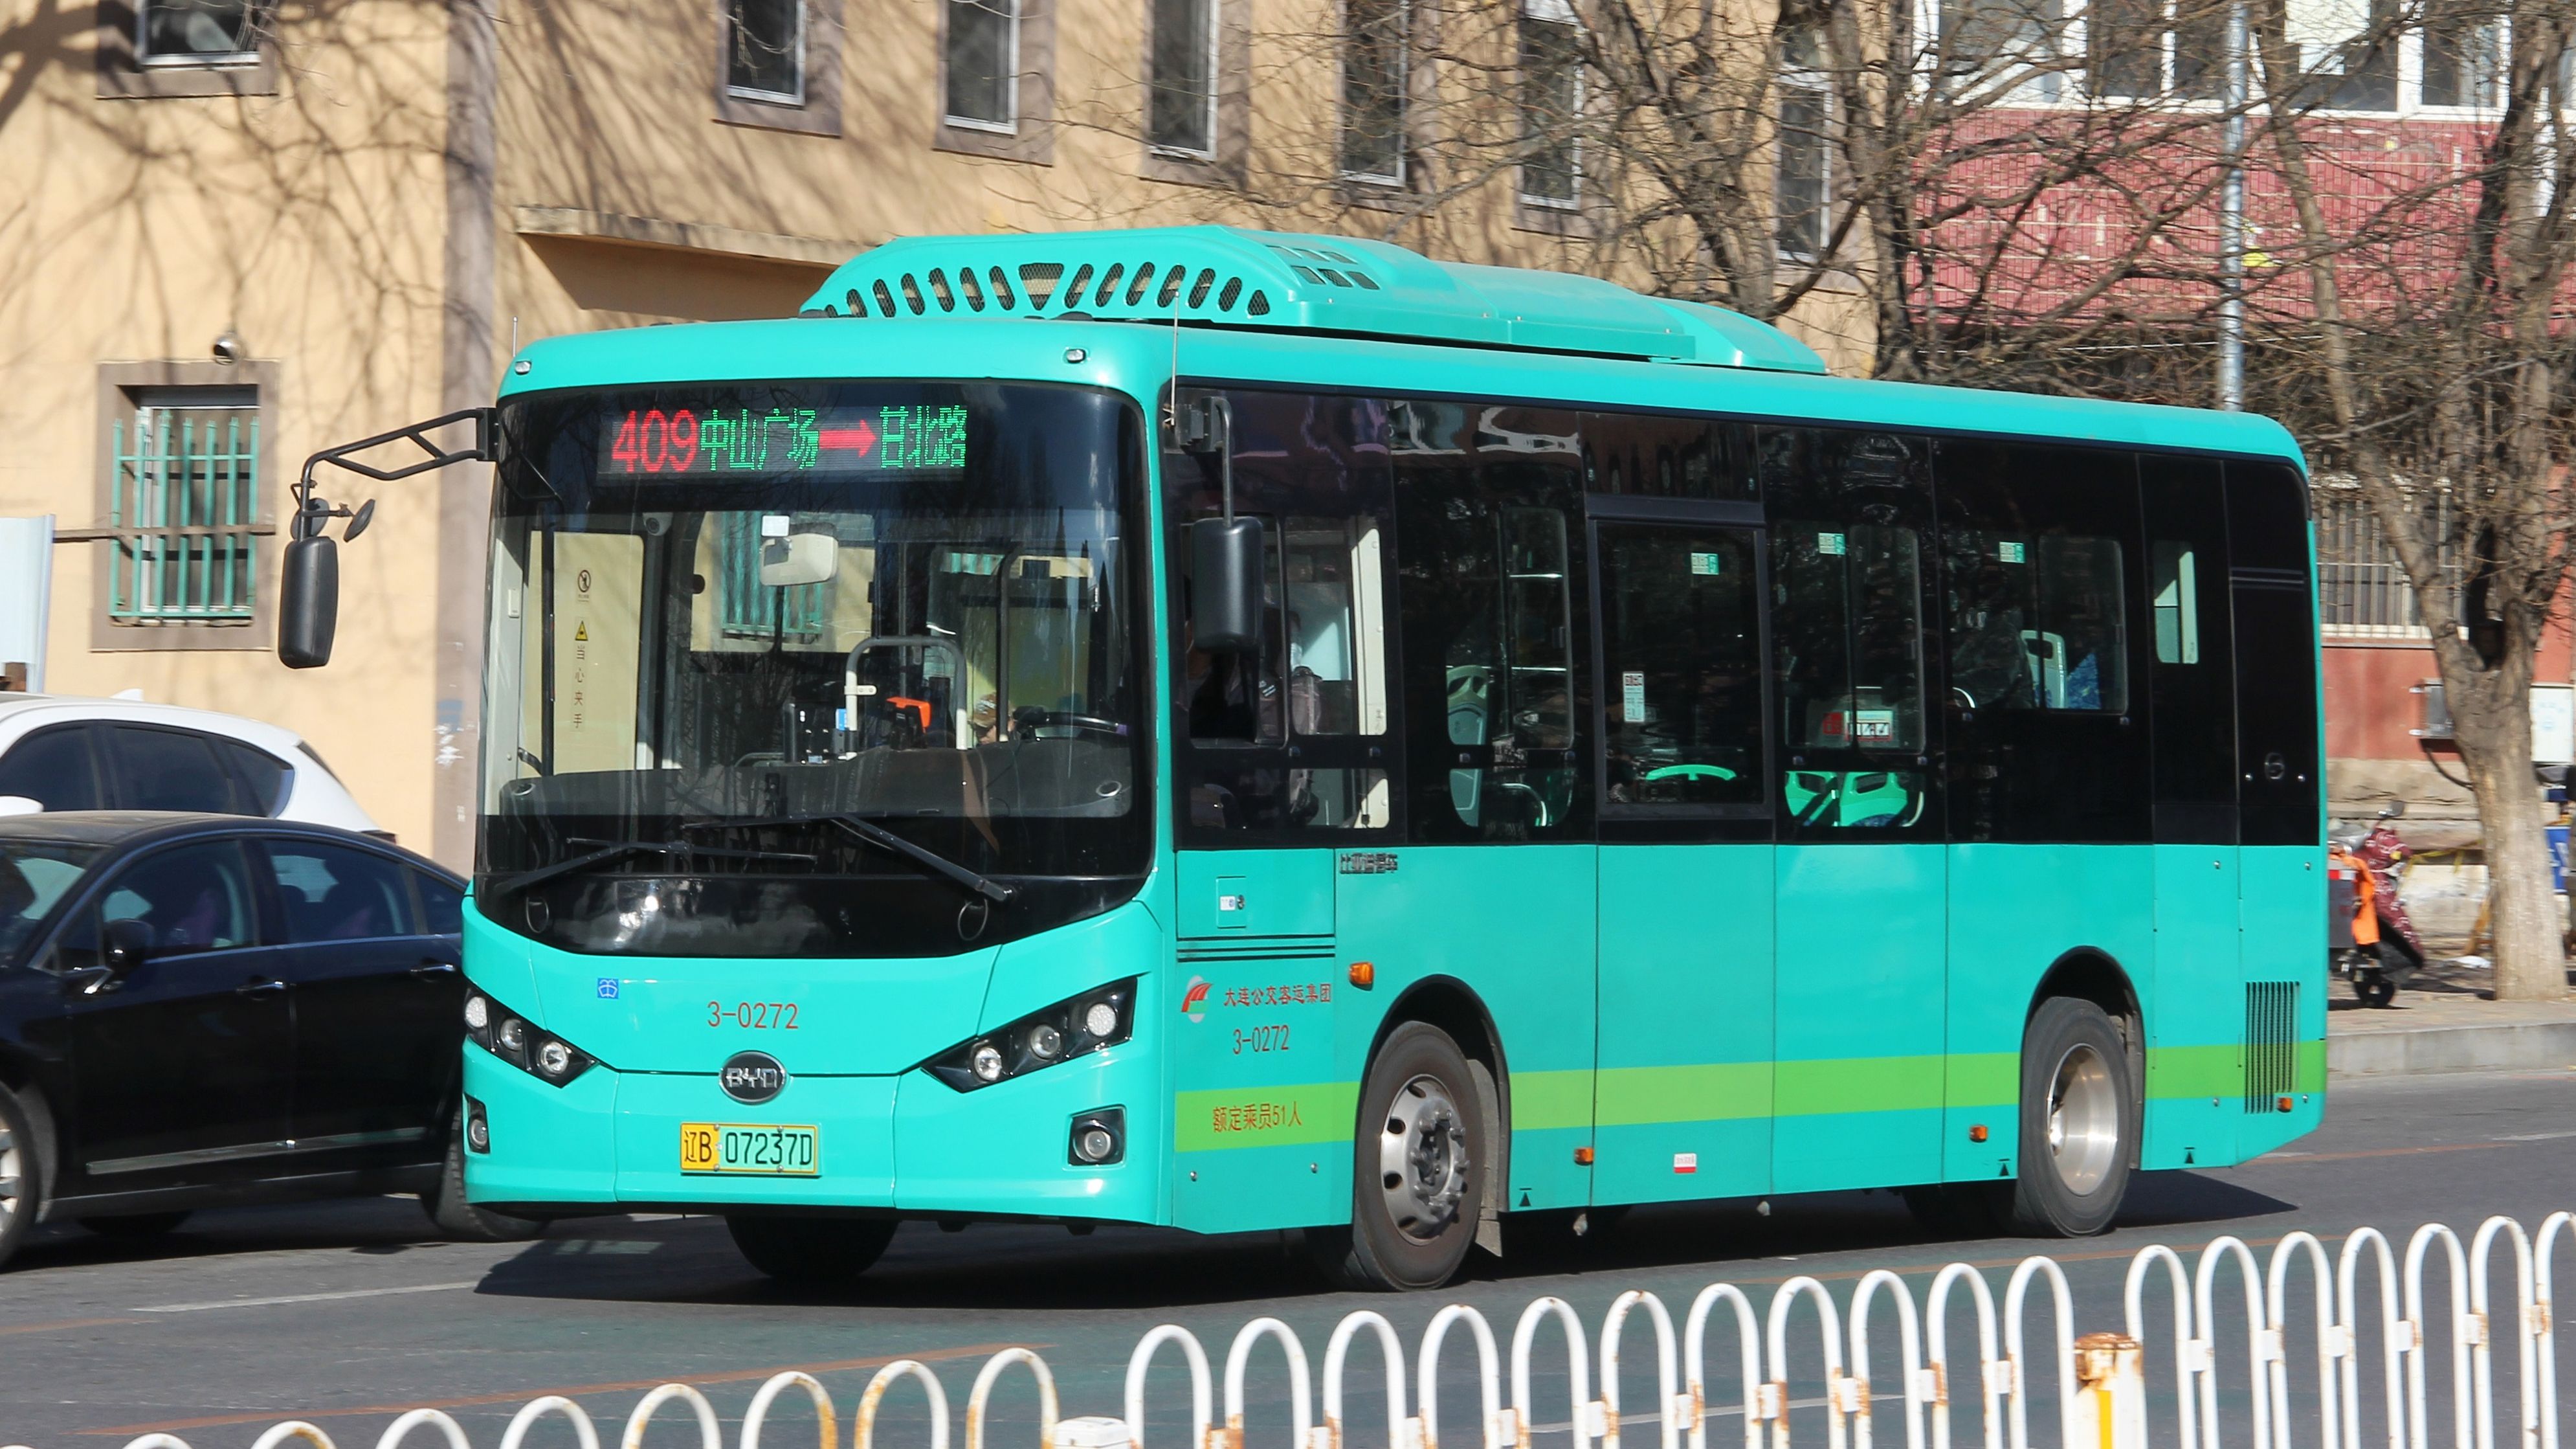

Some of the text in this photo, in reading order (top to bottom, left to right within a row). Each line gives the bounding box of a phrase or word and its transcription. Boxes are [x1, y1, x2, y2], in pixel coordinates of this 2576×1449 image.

[612, 410, 697, 473] 409
[700, 408, 819, 471] 中山广场
[1223, 983, 1331, 1006] 大连公交客运集团
[707, 1001, 799, 1029] 3-0272
[1233, 1025, 1289, 1055] 3-0272
[726, 1068, 777, 1088] BYD
[1213, 1101, 1302, 1132] 额定乘员51人
[726, 1132, 812, 1165] 07237D
